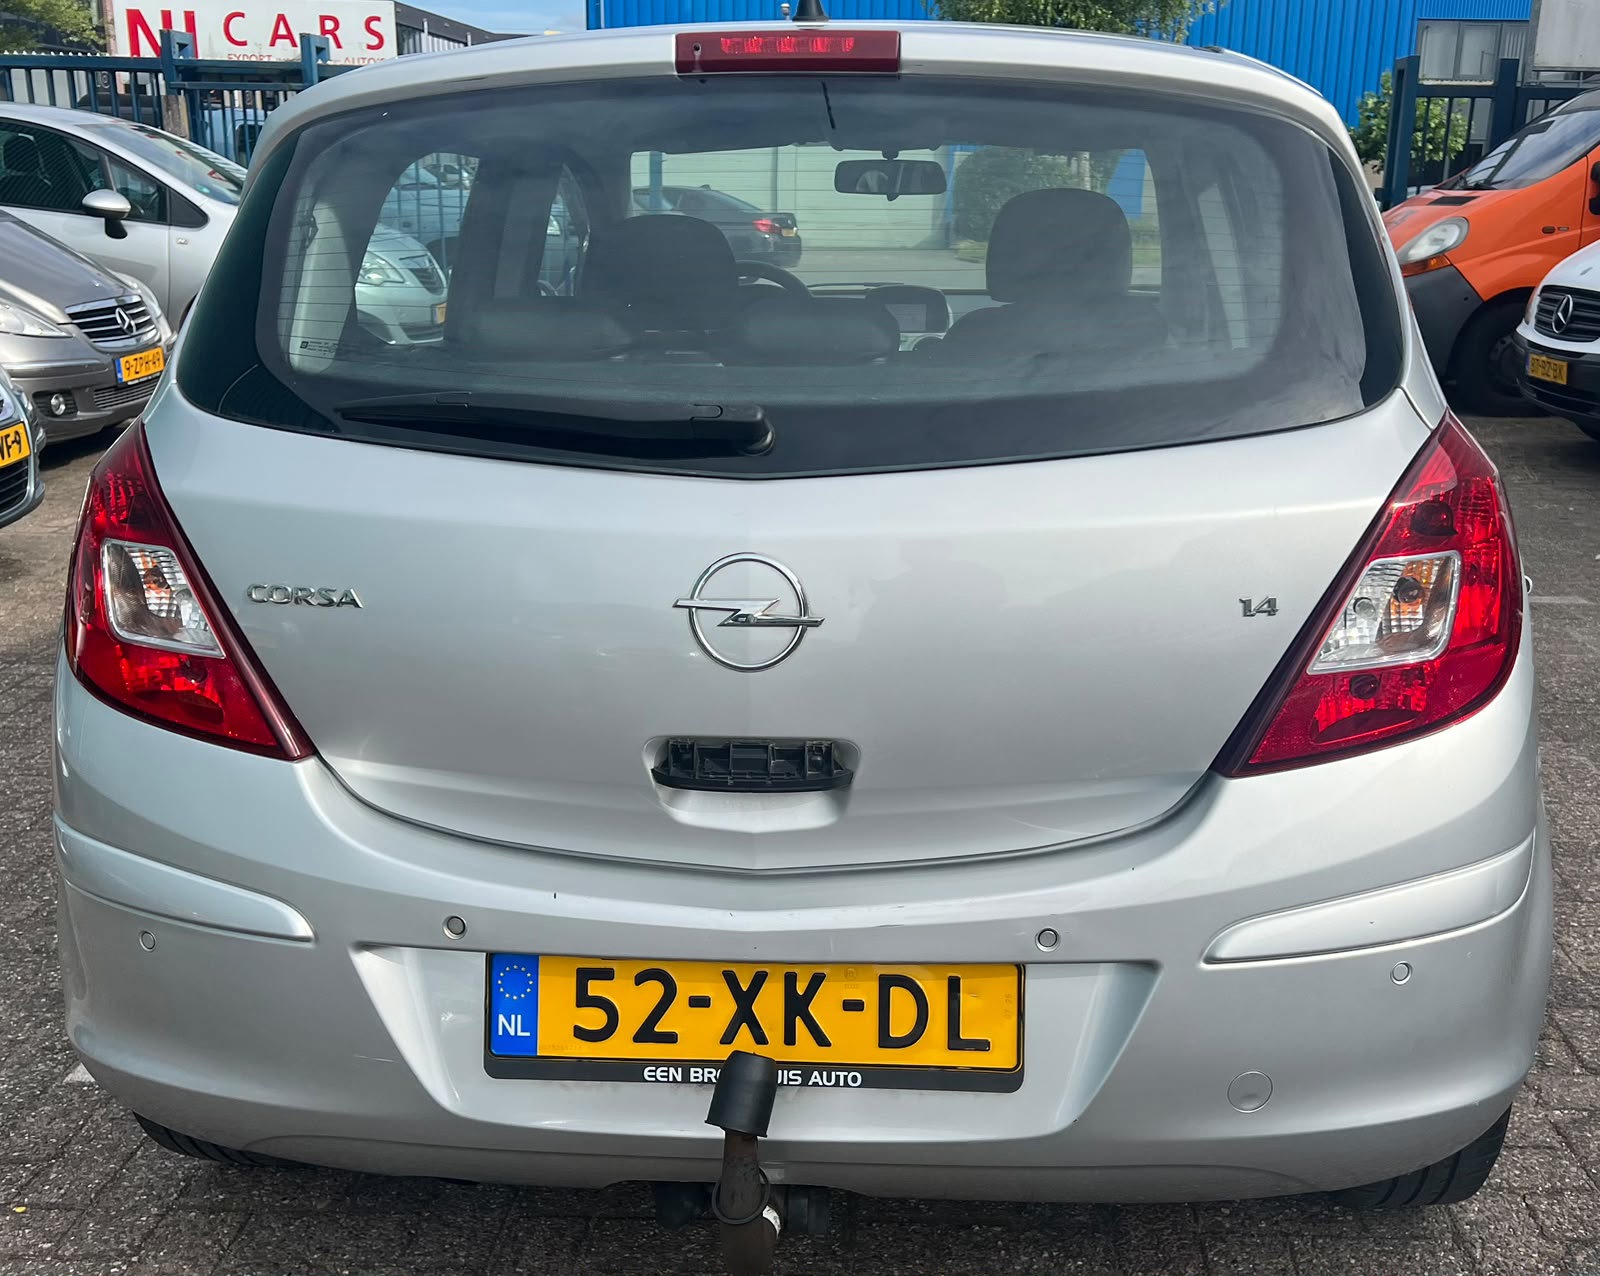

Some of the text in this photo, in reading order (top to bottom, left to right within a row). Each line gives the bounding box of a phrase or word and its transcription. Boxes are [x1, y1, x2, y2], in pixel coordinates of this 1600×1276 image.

[222, 11, 385, 51] CARS
[247, 583, 364, 609] CORSA
[572, 966, 991, 1052] 52-XK-DL
[497, 1013, 531, 1037] NL
[643, 1066, 682, 1082] EEN
[807, 1070, 863, 1087] AUTO
